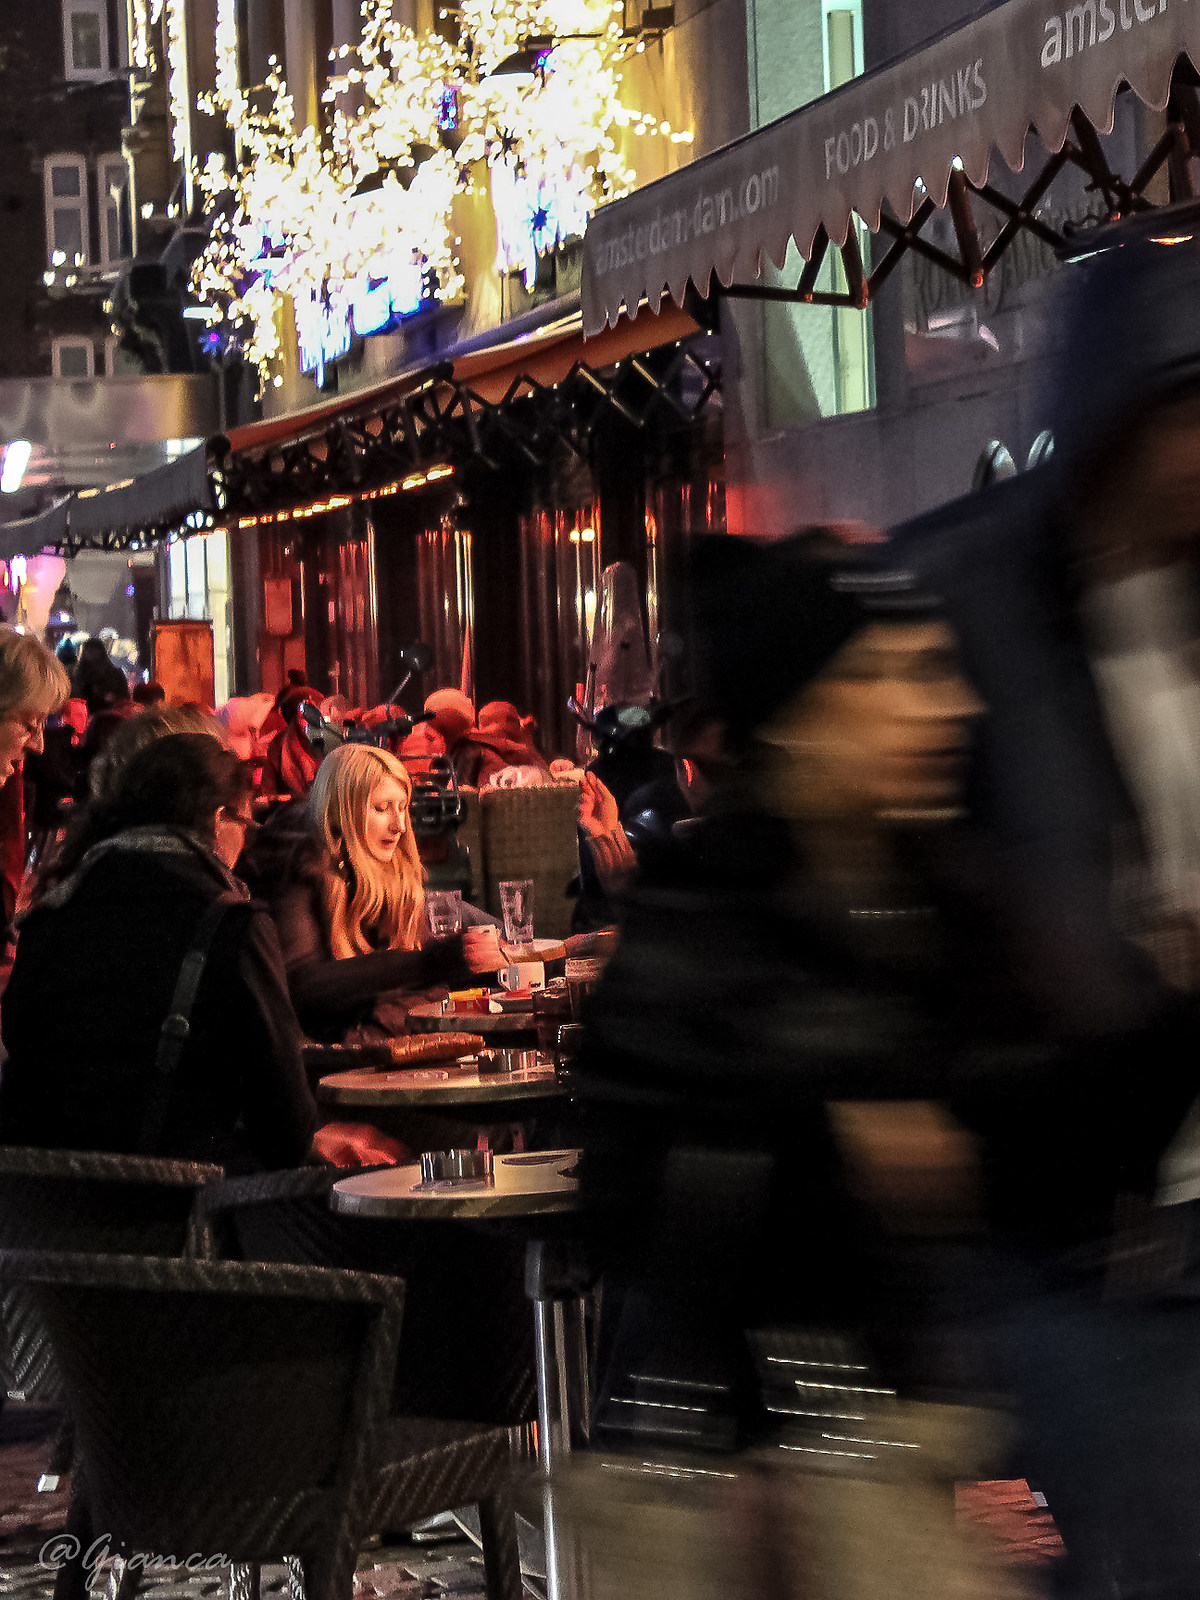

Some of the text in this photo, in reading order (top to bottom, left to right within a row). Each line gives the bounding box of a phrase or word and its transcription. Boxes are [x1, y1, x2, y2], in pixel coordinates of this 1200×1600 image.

[824, 58, 988, 180] FOOD & DRINKS
